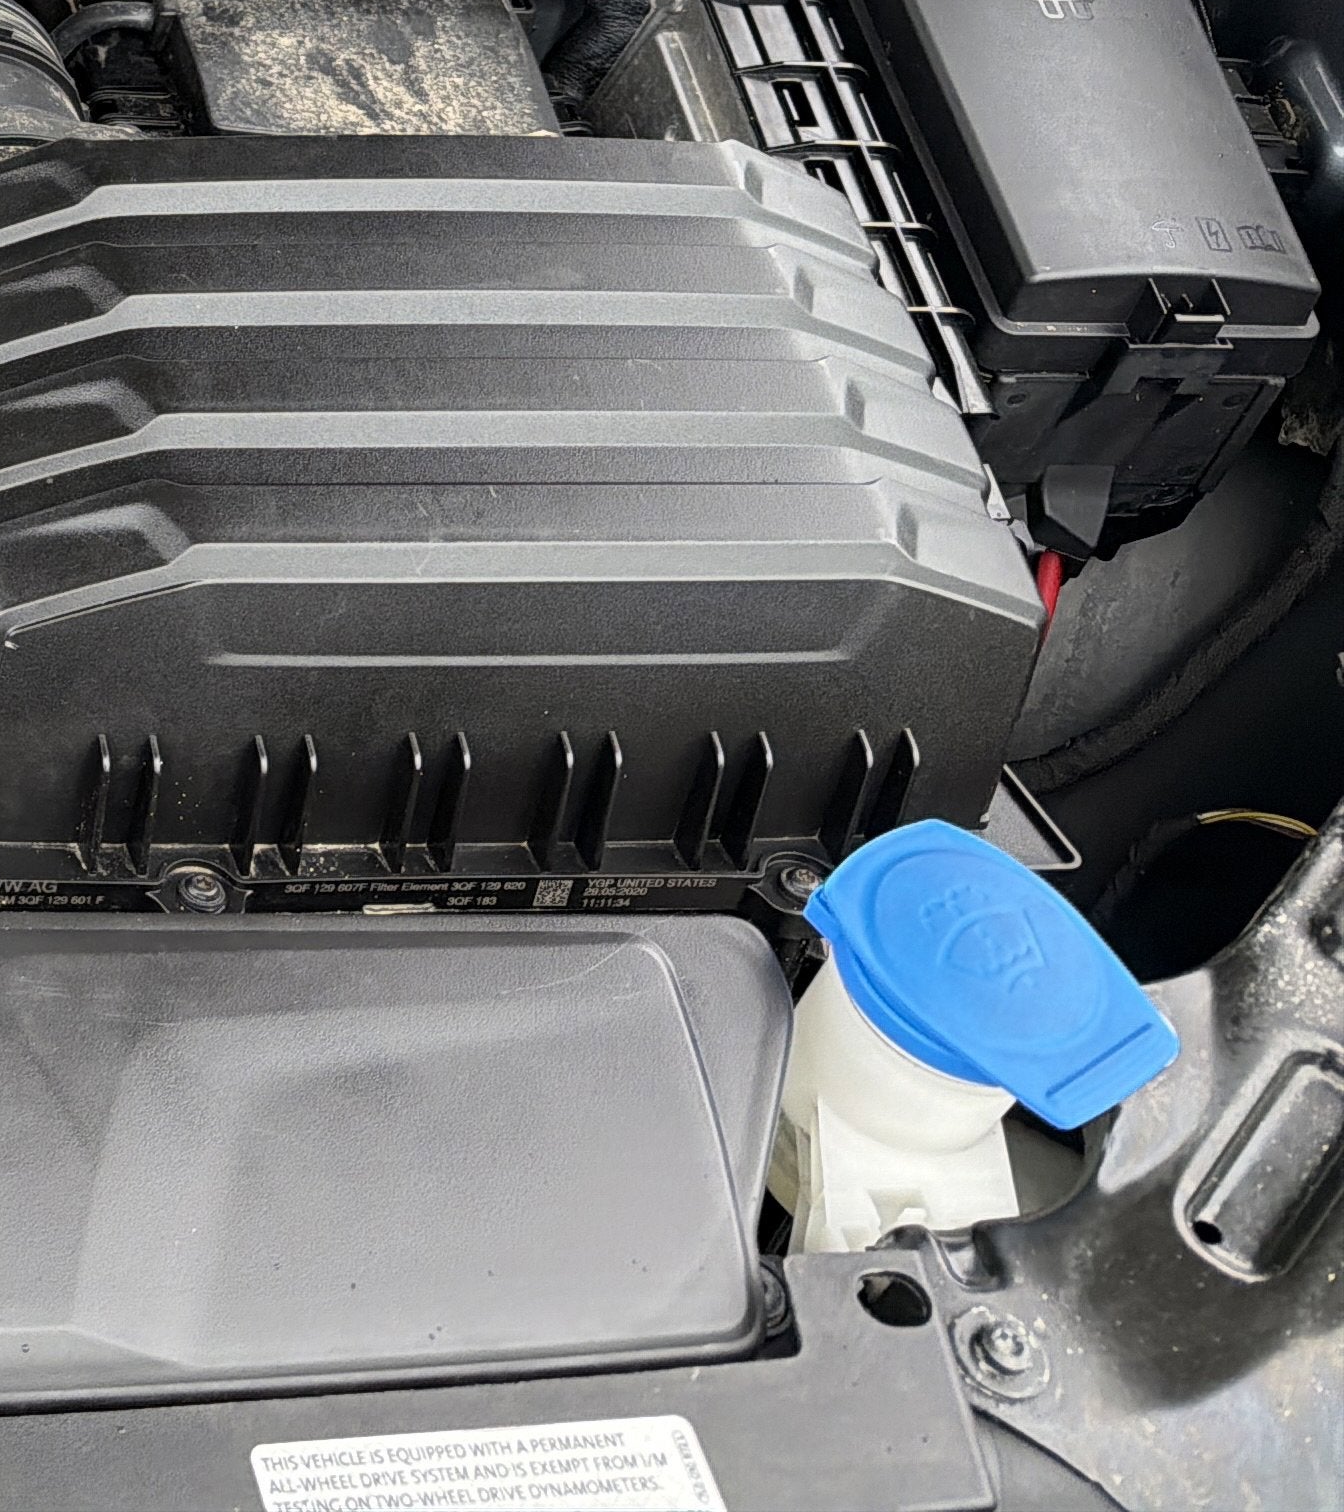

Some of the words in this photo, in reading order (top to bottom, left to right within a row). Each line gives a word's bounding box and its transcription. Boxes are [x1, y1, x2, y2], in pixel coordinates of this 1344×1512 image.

[27, 880, 58, 893] AG
[284, 883, 311, 894] 3QF
[369, 881, 400, 892] Filter
[401, 881, 449, 892] Element
[450, 881, 478, 892] 3QF
[480, 881, 502, 891] 129
[504, 881, 526, 890] 620
[587, 878, 615, 888] YGP
[617, 878, 664, 888] UNITED
[666, 878, 717, 888] STATES
[17, 895, 45, 905] 3QF
[48, 895, 69, 905] 129
[70, 895, 92, 905] 601
[96, 895, 105, 905] F
[446, 896, 473, 906] 3QF
[476, 896, 497, 906] 183
[261, 1455, 299, 1473] THIS
[300, 1449, 366, 1470] VEHICLE
[369, 1449, 385, 1465] IS
[387, 1444, 467, 1465] EQUIPPED
[469, 1440, 512, 1458] WITH
[516, 1439, 529, 1455] A
[531, 1432, 625, 1454] PERMANENT
[269, 1473, 358, 1495] ALL-WHEEL
[361, 1470, 407, 1489] DRIVE
[411, 1465, 470, 1485] SYSTEM
[473, 1462, 510, 1481] AND
[512, 1461, 528, 1478] IS
[530, 1456, 591, 1477] EXEMPT
[593, 1453, 639, 1472] FROM
[273, 1497, 340, 1512] TESTING
[344, 1494, 373, 1512] ON
[373, 1487, 475, 1509] TWO-WHEEL
[478, 1484, 527, 1505] DRIVE
